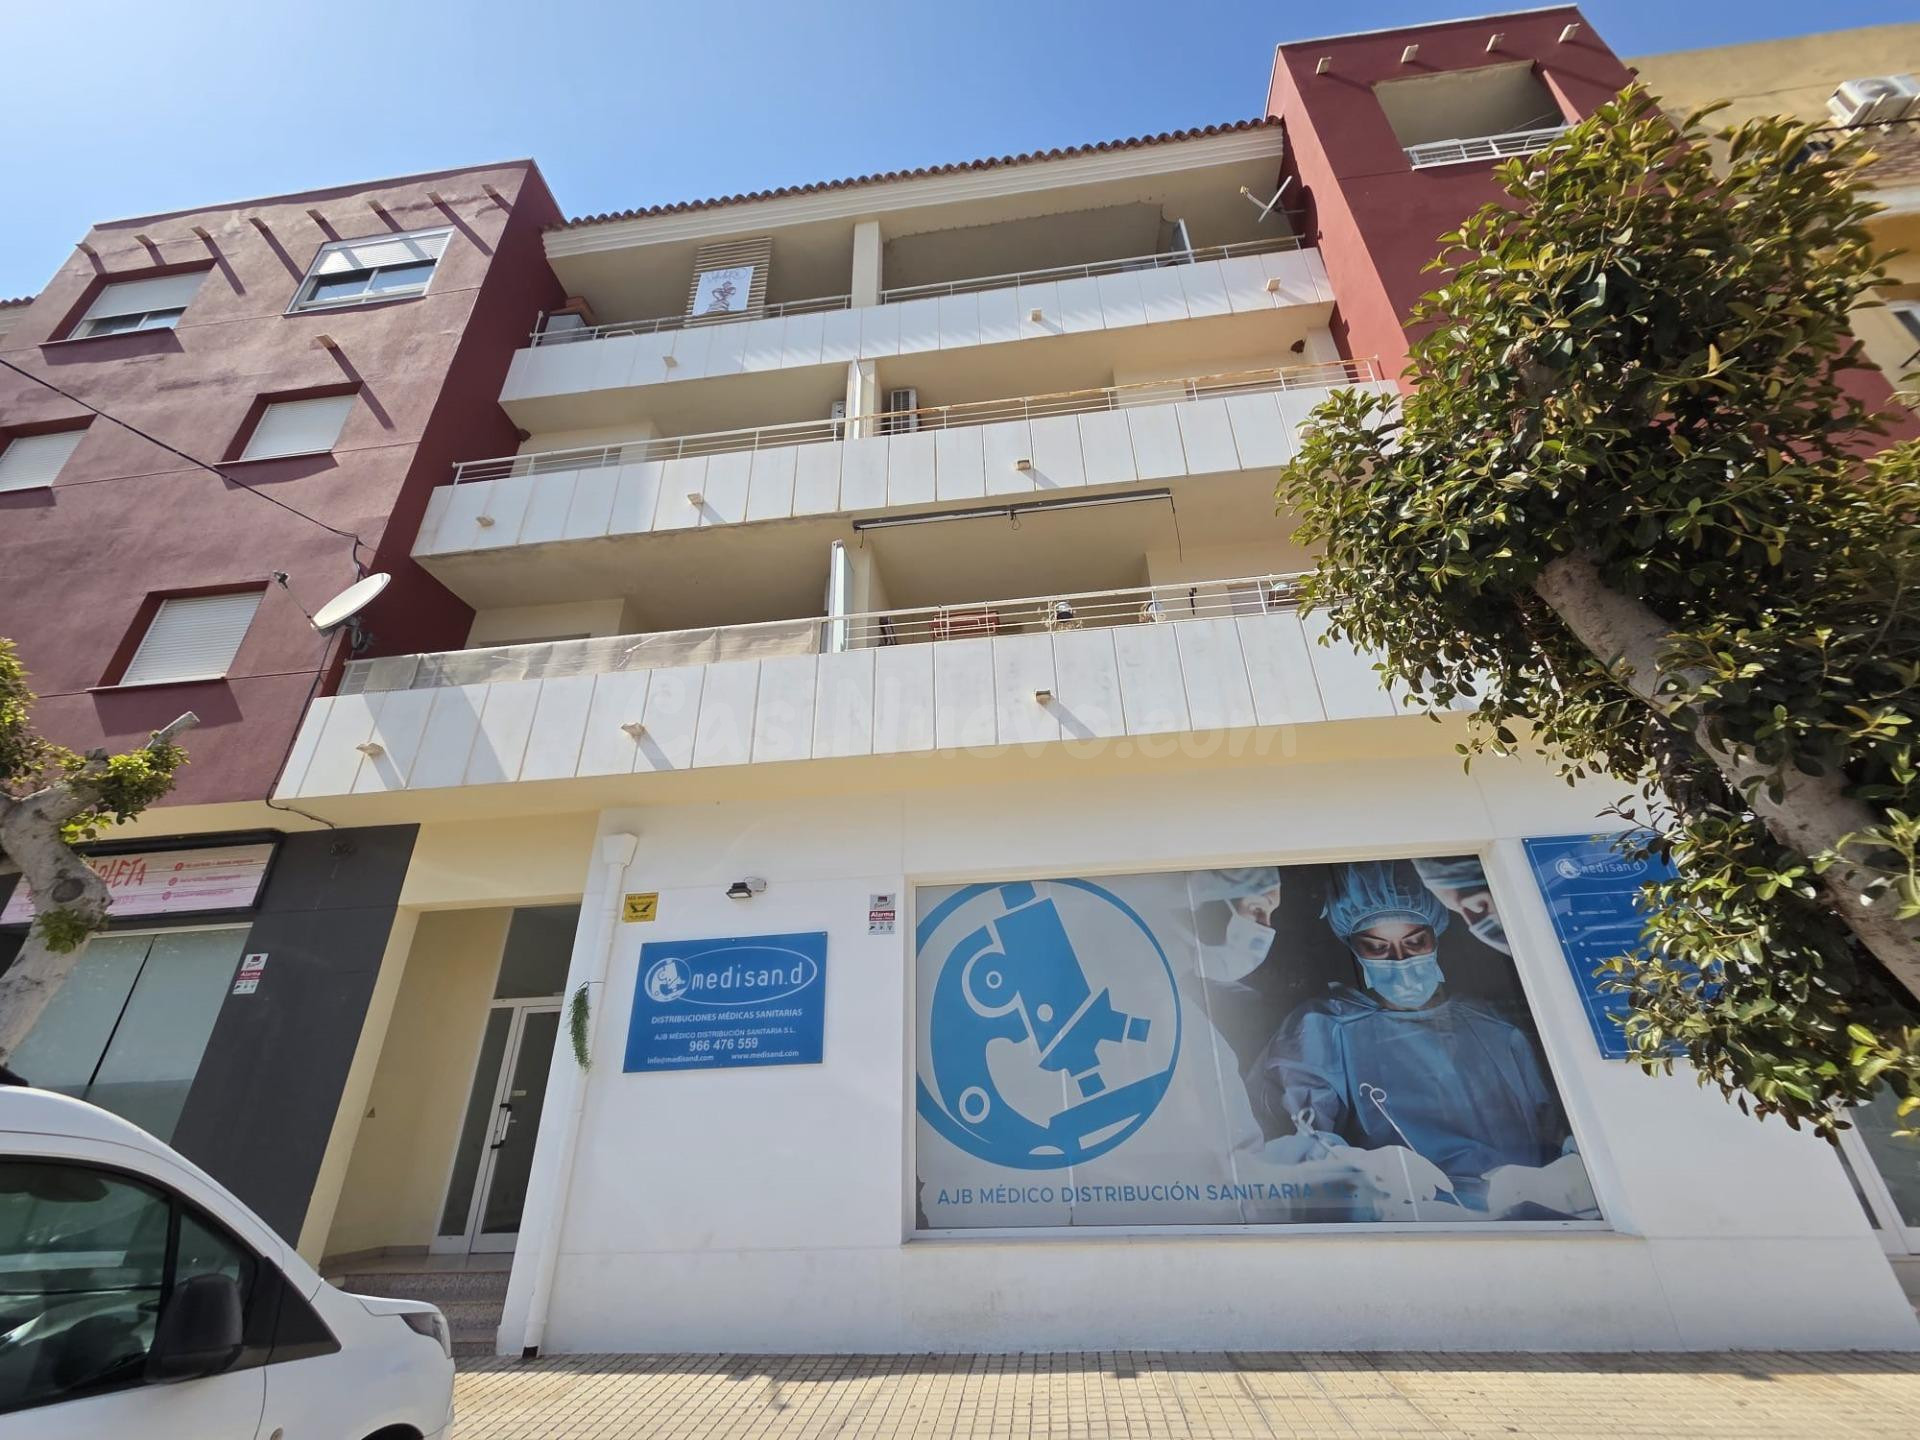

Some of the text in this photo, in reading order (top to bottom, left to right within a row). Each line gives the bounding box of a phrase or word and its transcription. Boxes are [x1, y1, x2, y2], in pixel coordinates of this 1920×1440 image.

[91, 856, 147, 889] OLETA
[692, 962, 802, 991] medisan.d
[651, 1008, 802, 1024] DISTRIBUCIONES MÉDICAS SANITARIAS
[669, 1031, 696, 1040] MÉDICO
[697, 1028, 745, 1039] DISTRIBUCIÓN
[746, 1027, 783, 1036] SANITARIA
[689, 1037, 759, 1052] 966 476 559
[731, 1049, 800, 1060] www.medisand.com
[937, 1188, 973, 1205] AJB
[980, 1183, 1055, 1204] MÉDICO
[1061, 1180, 1200, 1203] DISTRIBUCIÓN
[1206, 1182, 1313, 1200] SANITARIA
